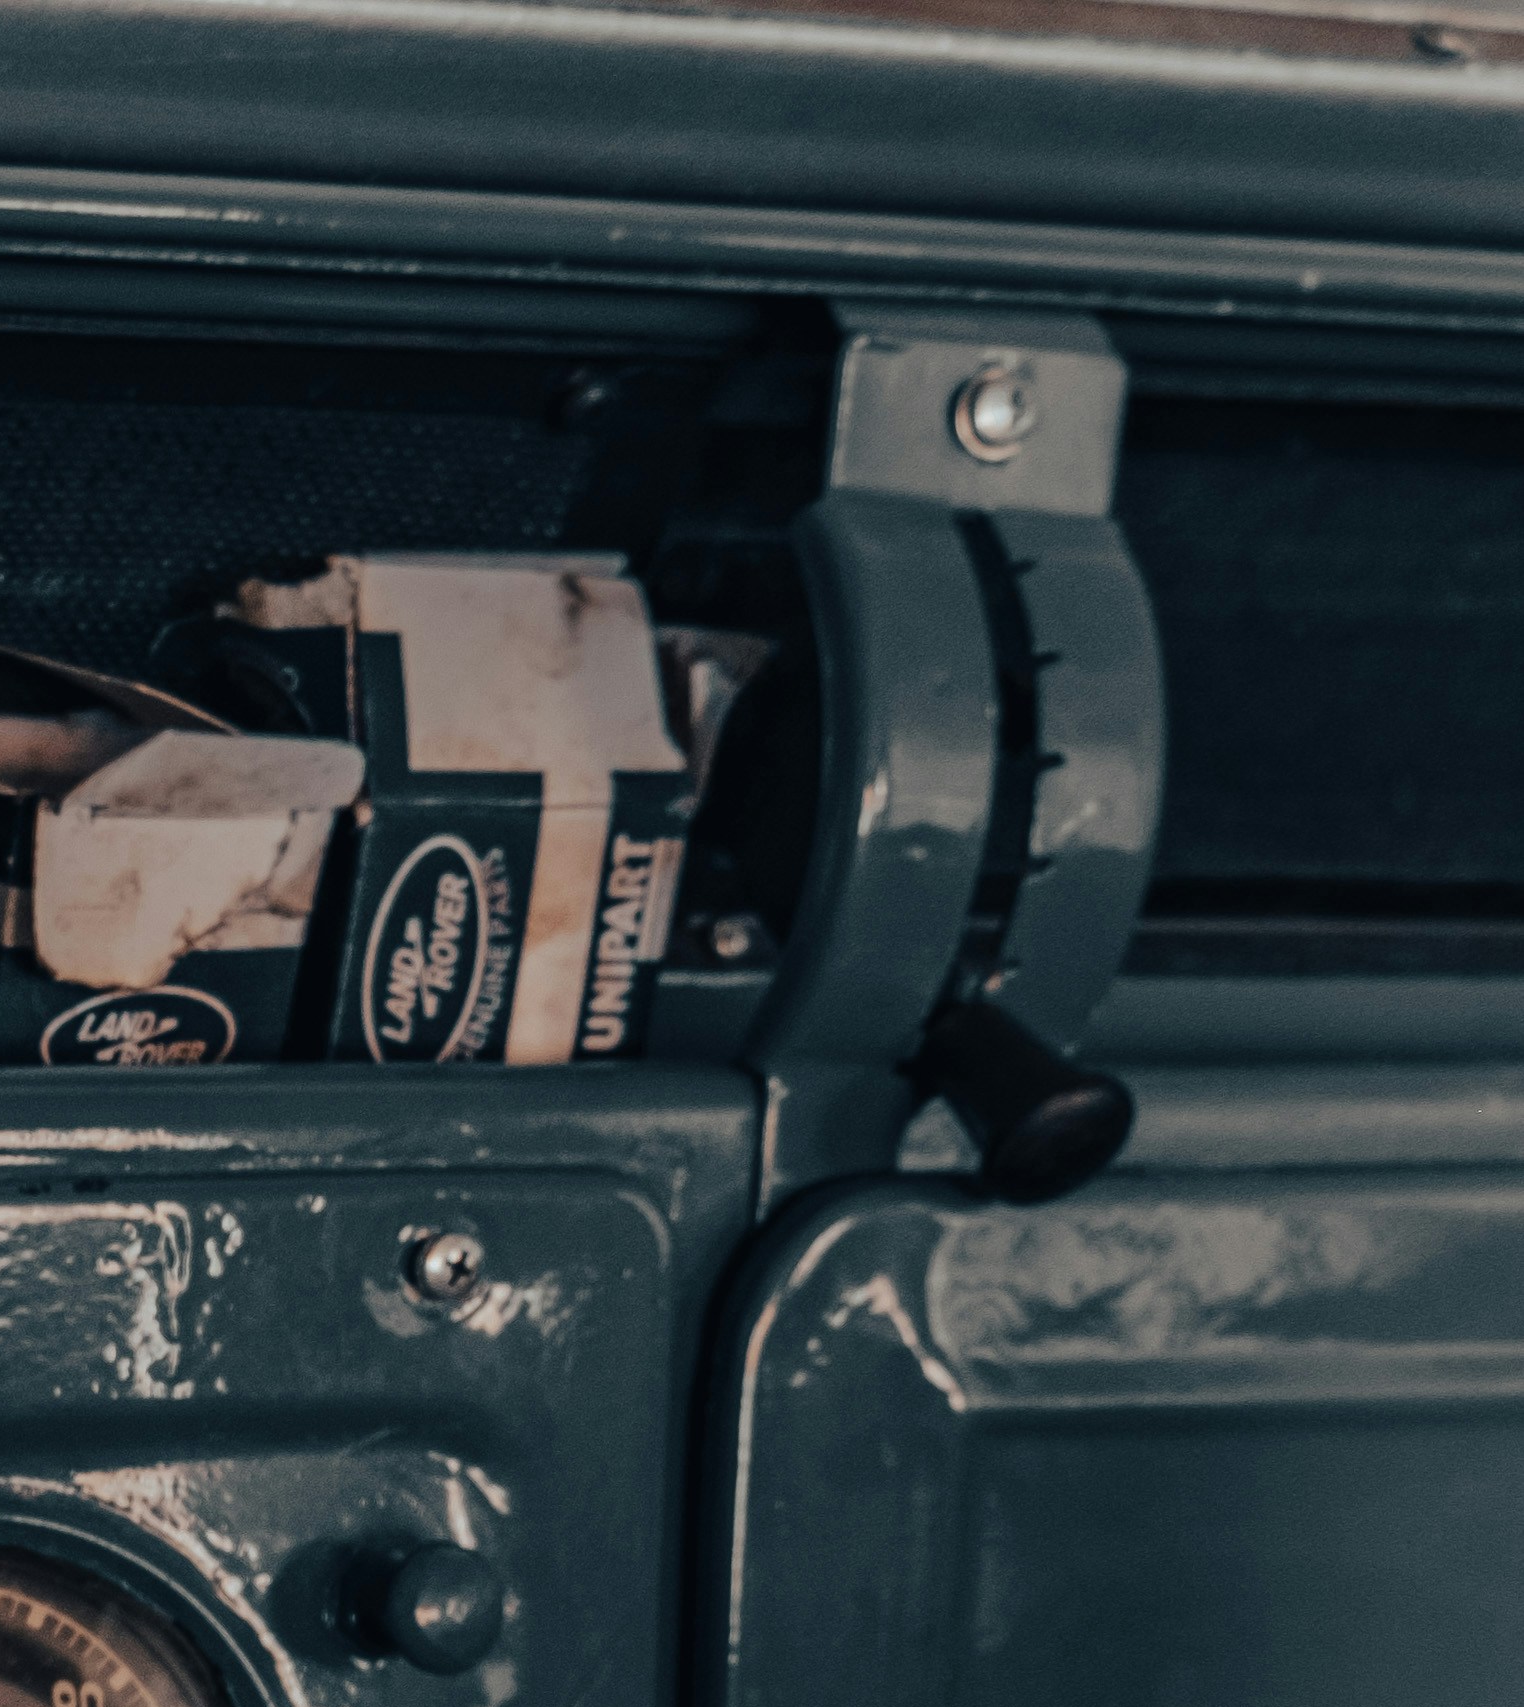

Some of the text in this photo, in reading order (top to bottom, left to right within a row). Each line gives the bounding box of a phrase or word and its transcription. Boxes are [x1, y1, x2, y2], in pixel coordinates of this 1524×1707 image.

[422, 871, 470, 993] ROVER
[581, 834, 655, 1053] UNIPART
[76, 1010, 157, 1043] LAND
[380, 945, 426, 1044] LAND
